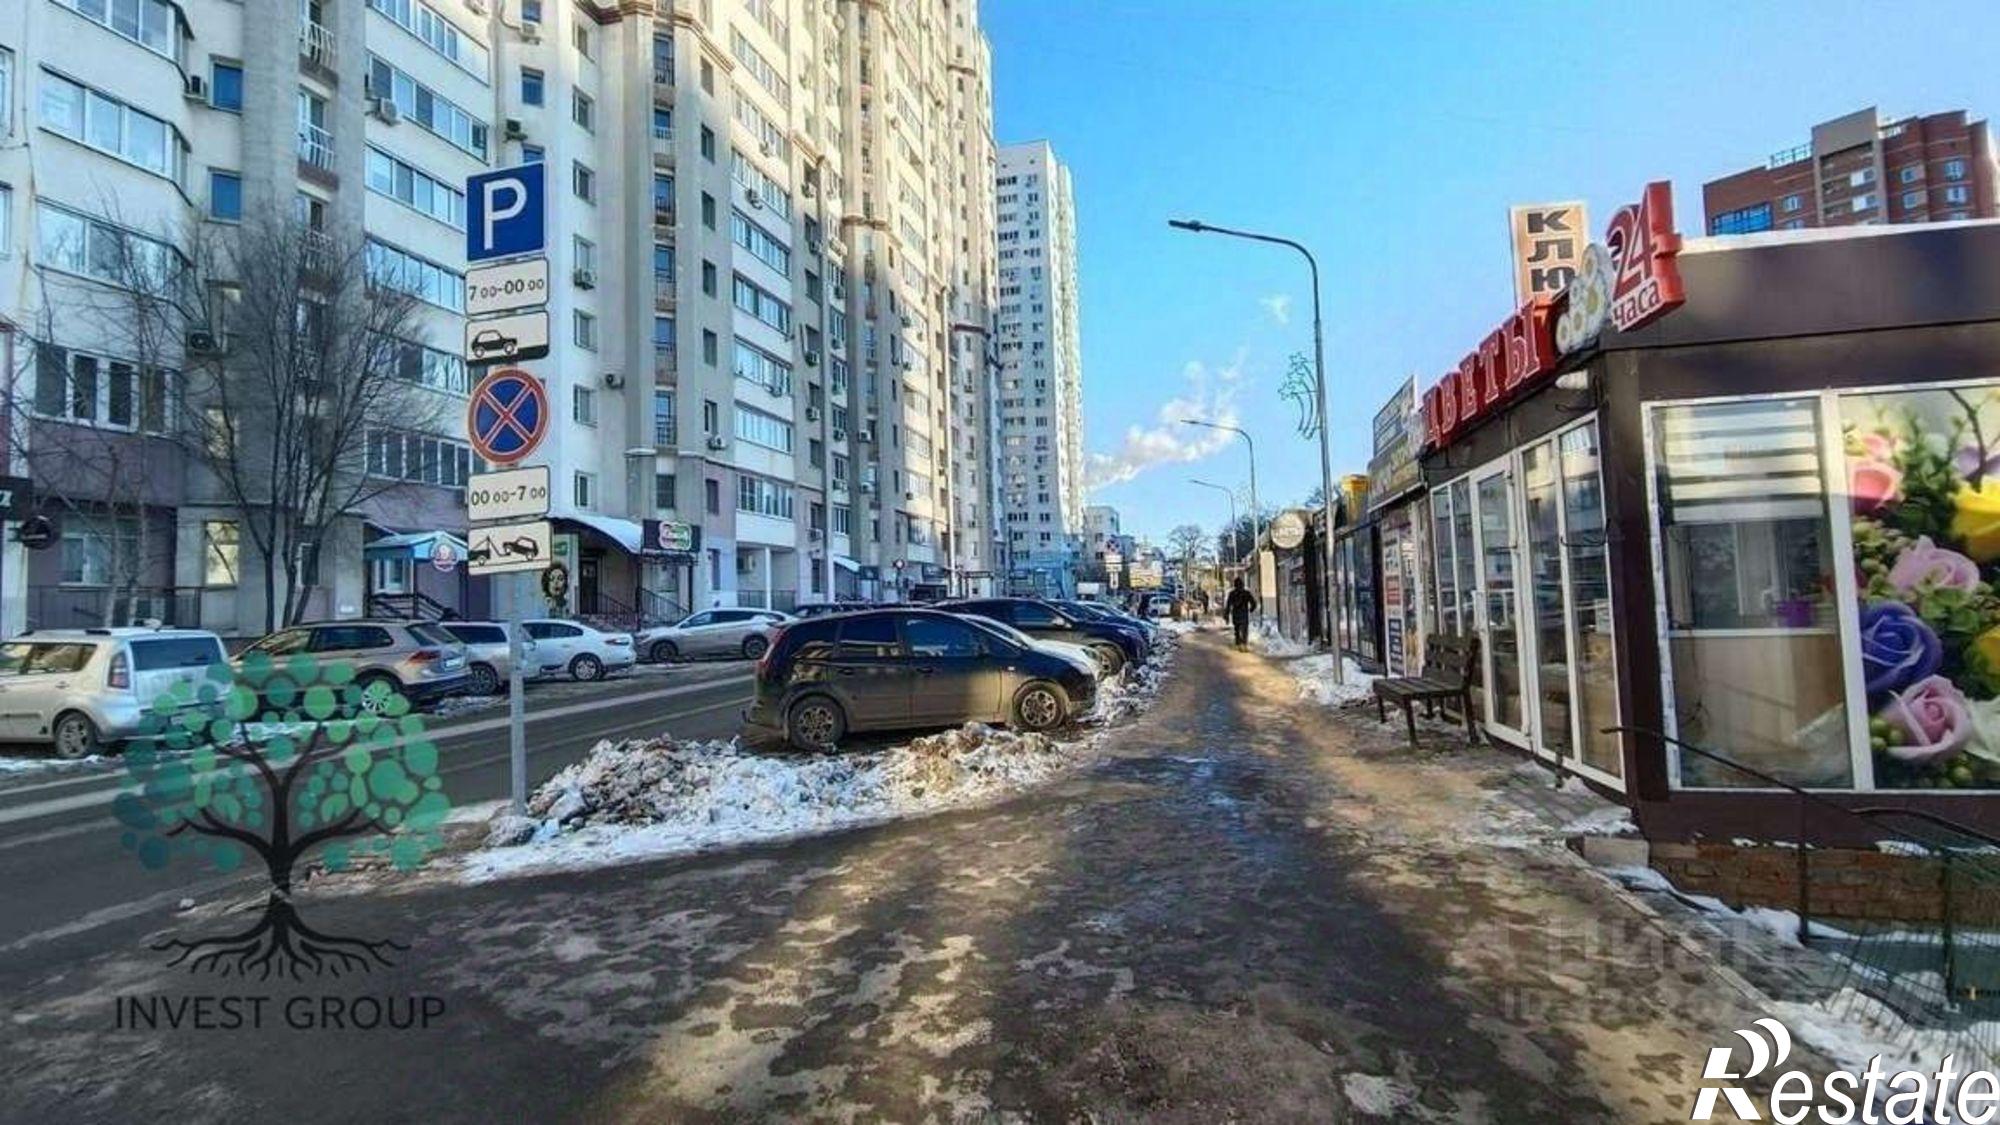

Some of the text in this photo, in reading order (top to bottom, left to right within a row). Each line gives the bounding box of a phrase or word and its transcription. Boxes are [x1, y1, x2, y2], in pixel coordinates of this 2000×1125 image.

[484, 177, 527, 250] P
[1605, 182, 1666, 300] 24
[1612, 281, 1660, 326] часа
[1421, 301, 1545, 450] ЦВЕТЫ
